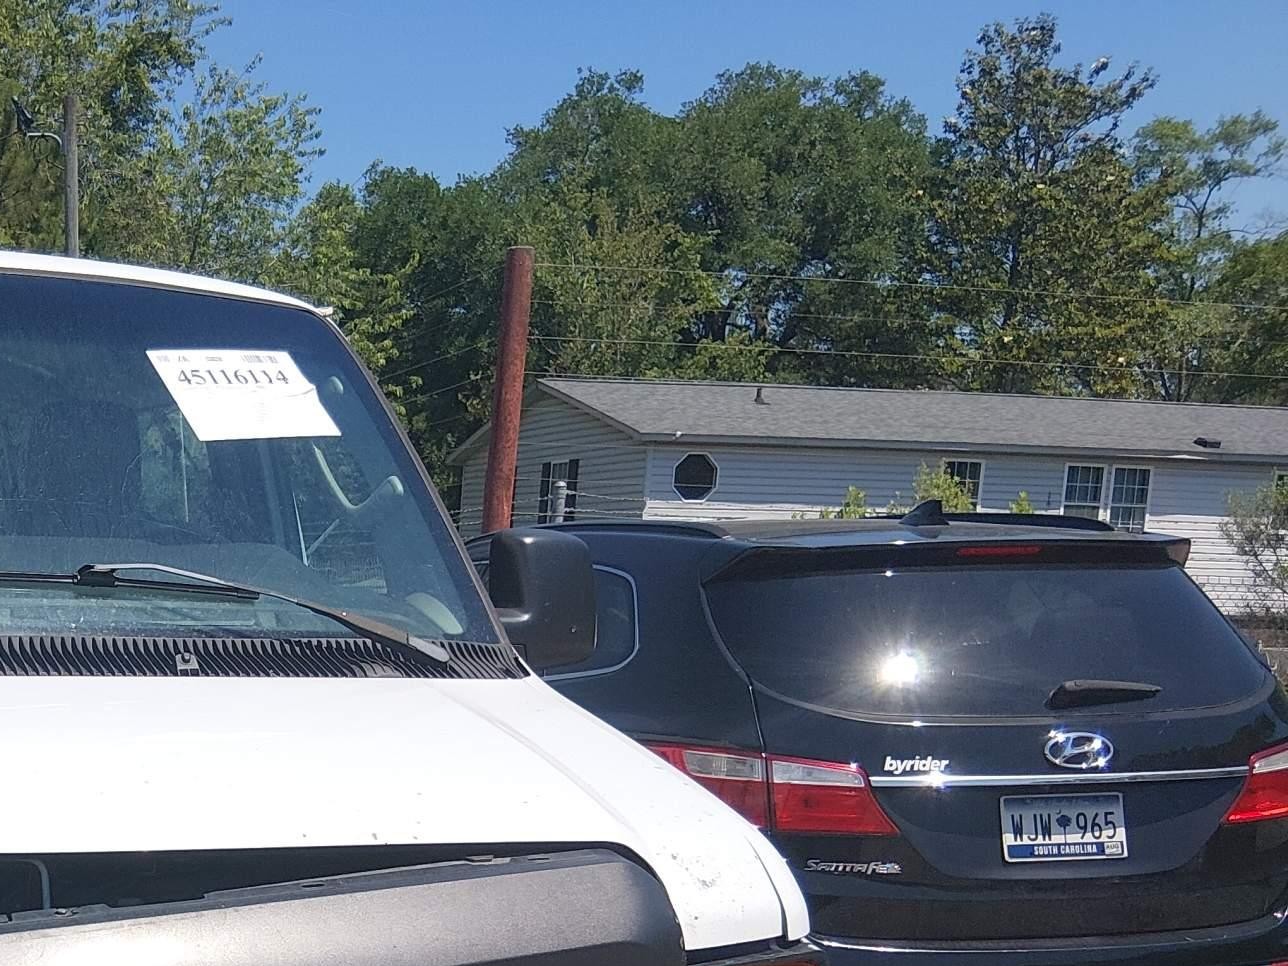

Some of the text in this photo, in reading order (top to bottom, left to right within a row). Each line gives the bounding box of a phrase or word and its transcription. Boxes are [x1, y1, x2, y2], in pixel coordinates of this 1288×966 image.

[177, 369, 289, 385] 45116114
[883, 755, 949, 775] byrider
[1011, 811, 1117, 842] WJW 965
[1033, 844, 1097, 855] SOUTH CAROLINA
